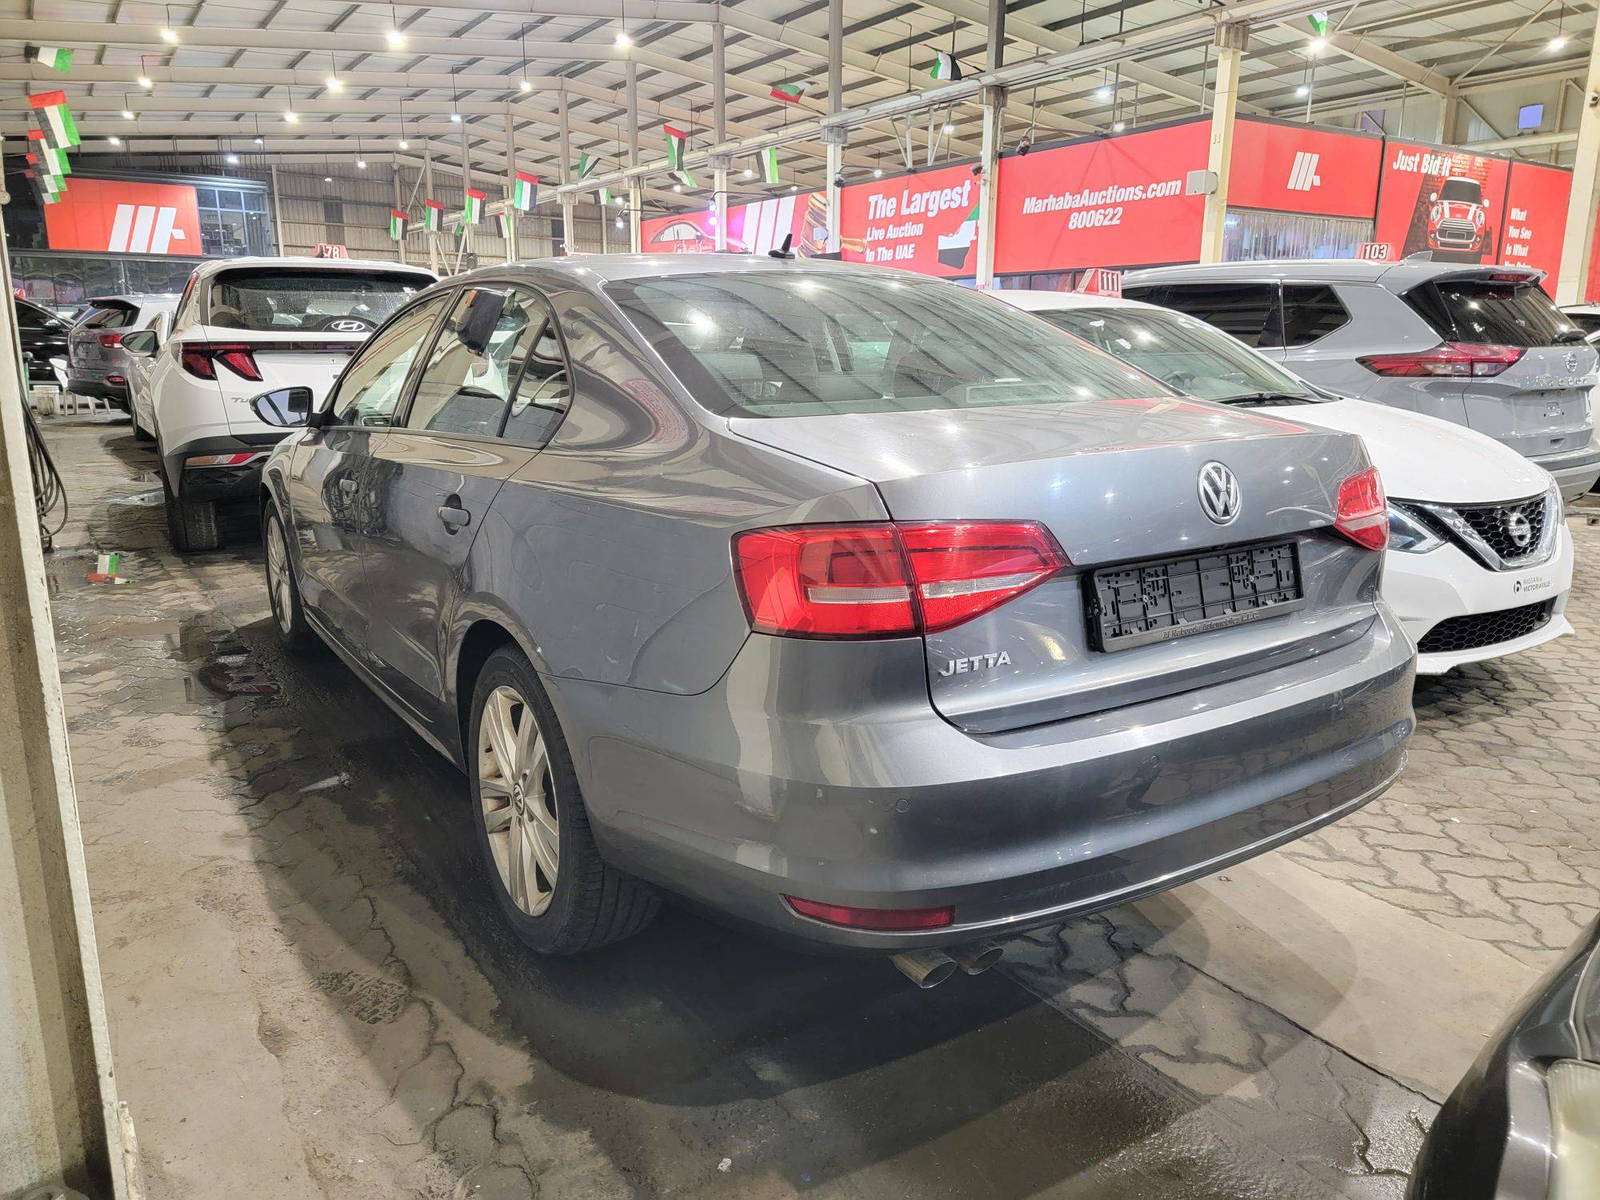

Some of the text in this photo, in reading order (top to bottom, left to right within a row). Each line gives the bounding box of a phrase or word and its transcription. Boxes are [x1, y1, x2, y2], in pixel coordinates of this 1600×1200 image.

[1393, 149, 1452, 177] Just Bid It
[868, 180, 971, 220] The Largest
[1022, 178, 1182, 215] MarhabaAuctions.com
[1068, 207, 1123, 230] 800622
[1510, 208, 1527, 221] What
[866, 221, 924, 241] Live Auction
[1508, 225, 1520, 239] You
[865, 244, 915, 262] In The UAE
[1365, 244, 1388, 259] 103
[1512, 243, 1529, 257] What
[1100, 272, 1119, 292] 111
[938, 649, 1012, 677] JETTA
